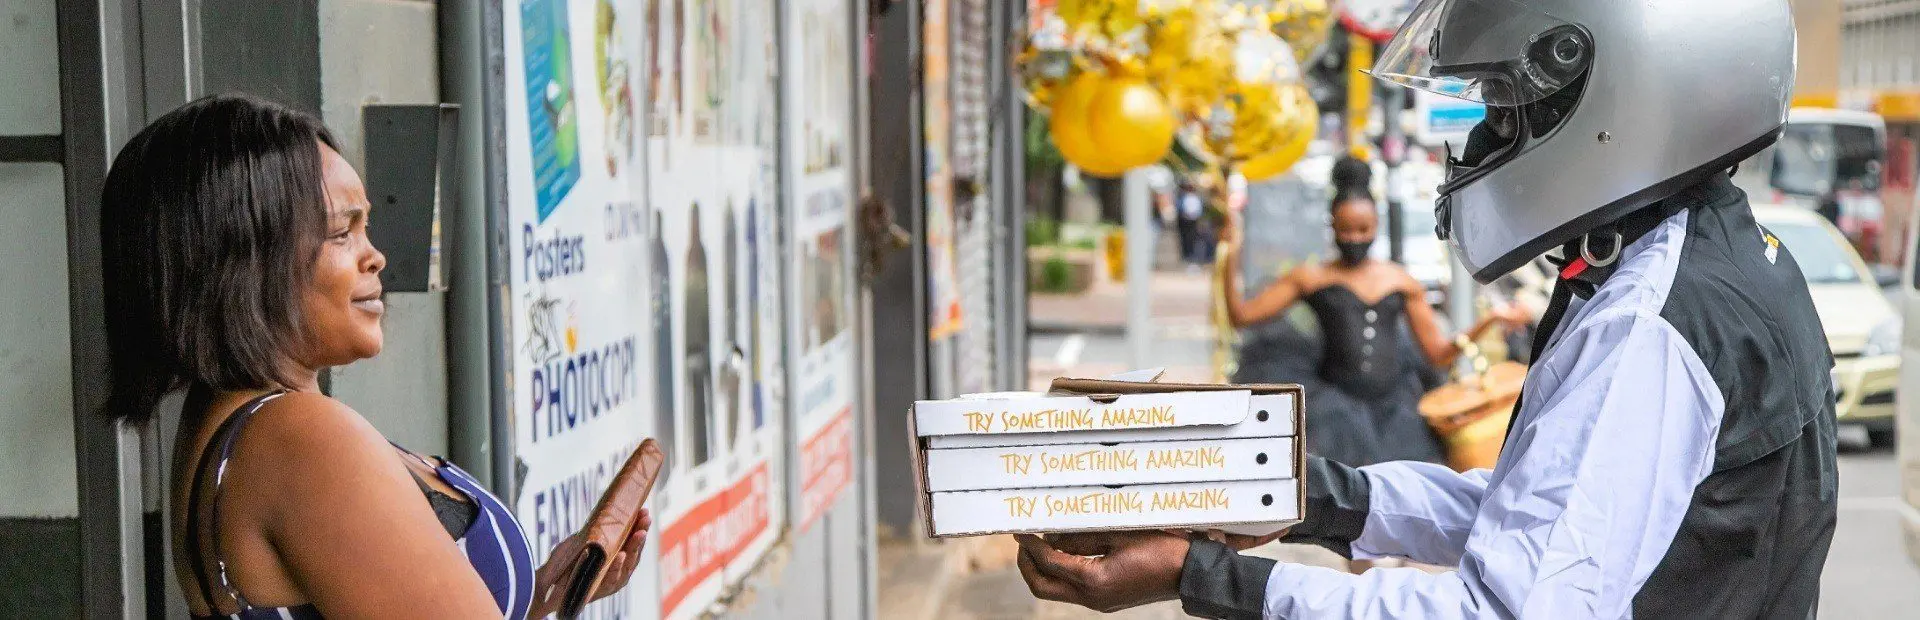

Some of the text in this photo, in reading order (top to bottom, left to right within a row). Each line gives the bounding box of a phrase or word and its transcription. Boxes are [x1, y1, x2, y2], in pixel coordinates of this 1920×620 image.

[522, 223, 585, 282] Posters
[531, 333, 637, 443] PHOTOCOPY
[963, 405, 1176, 433] TRY SOMETHING AMAZING
[999, 446, 1225, 476] TRY SOMETHING AMAZING
[1004, 488, 1230, 518] TRY SOMETHING AMAZING
